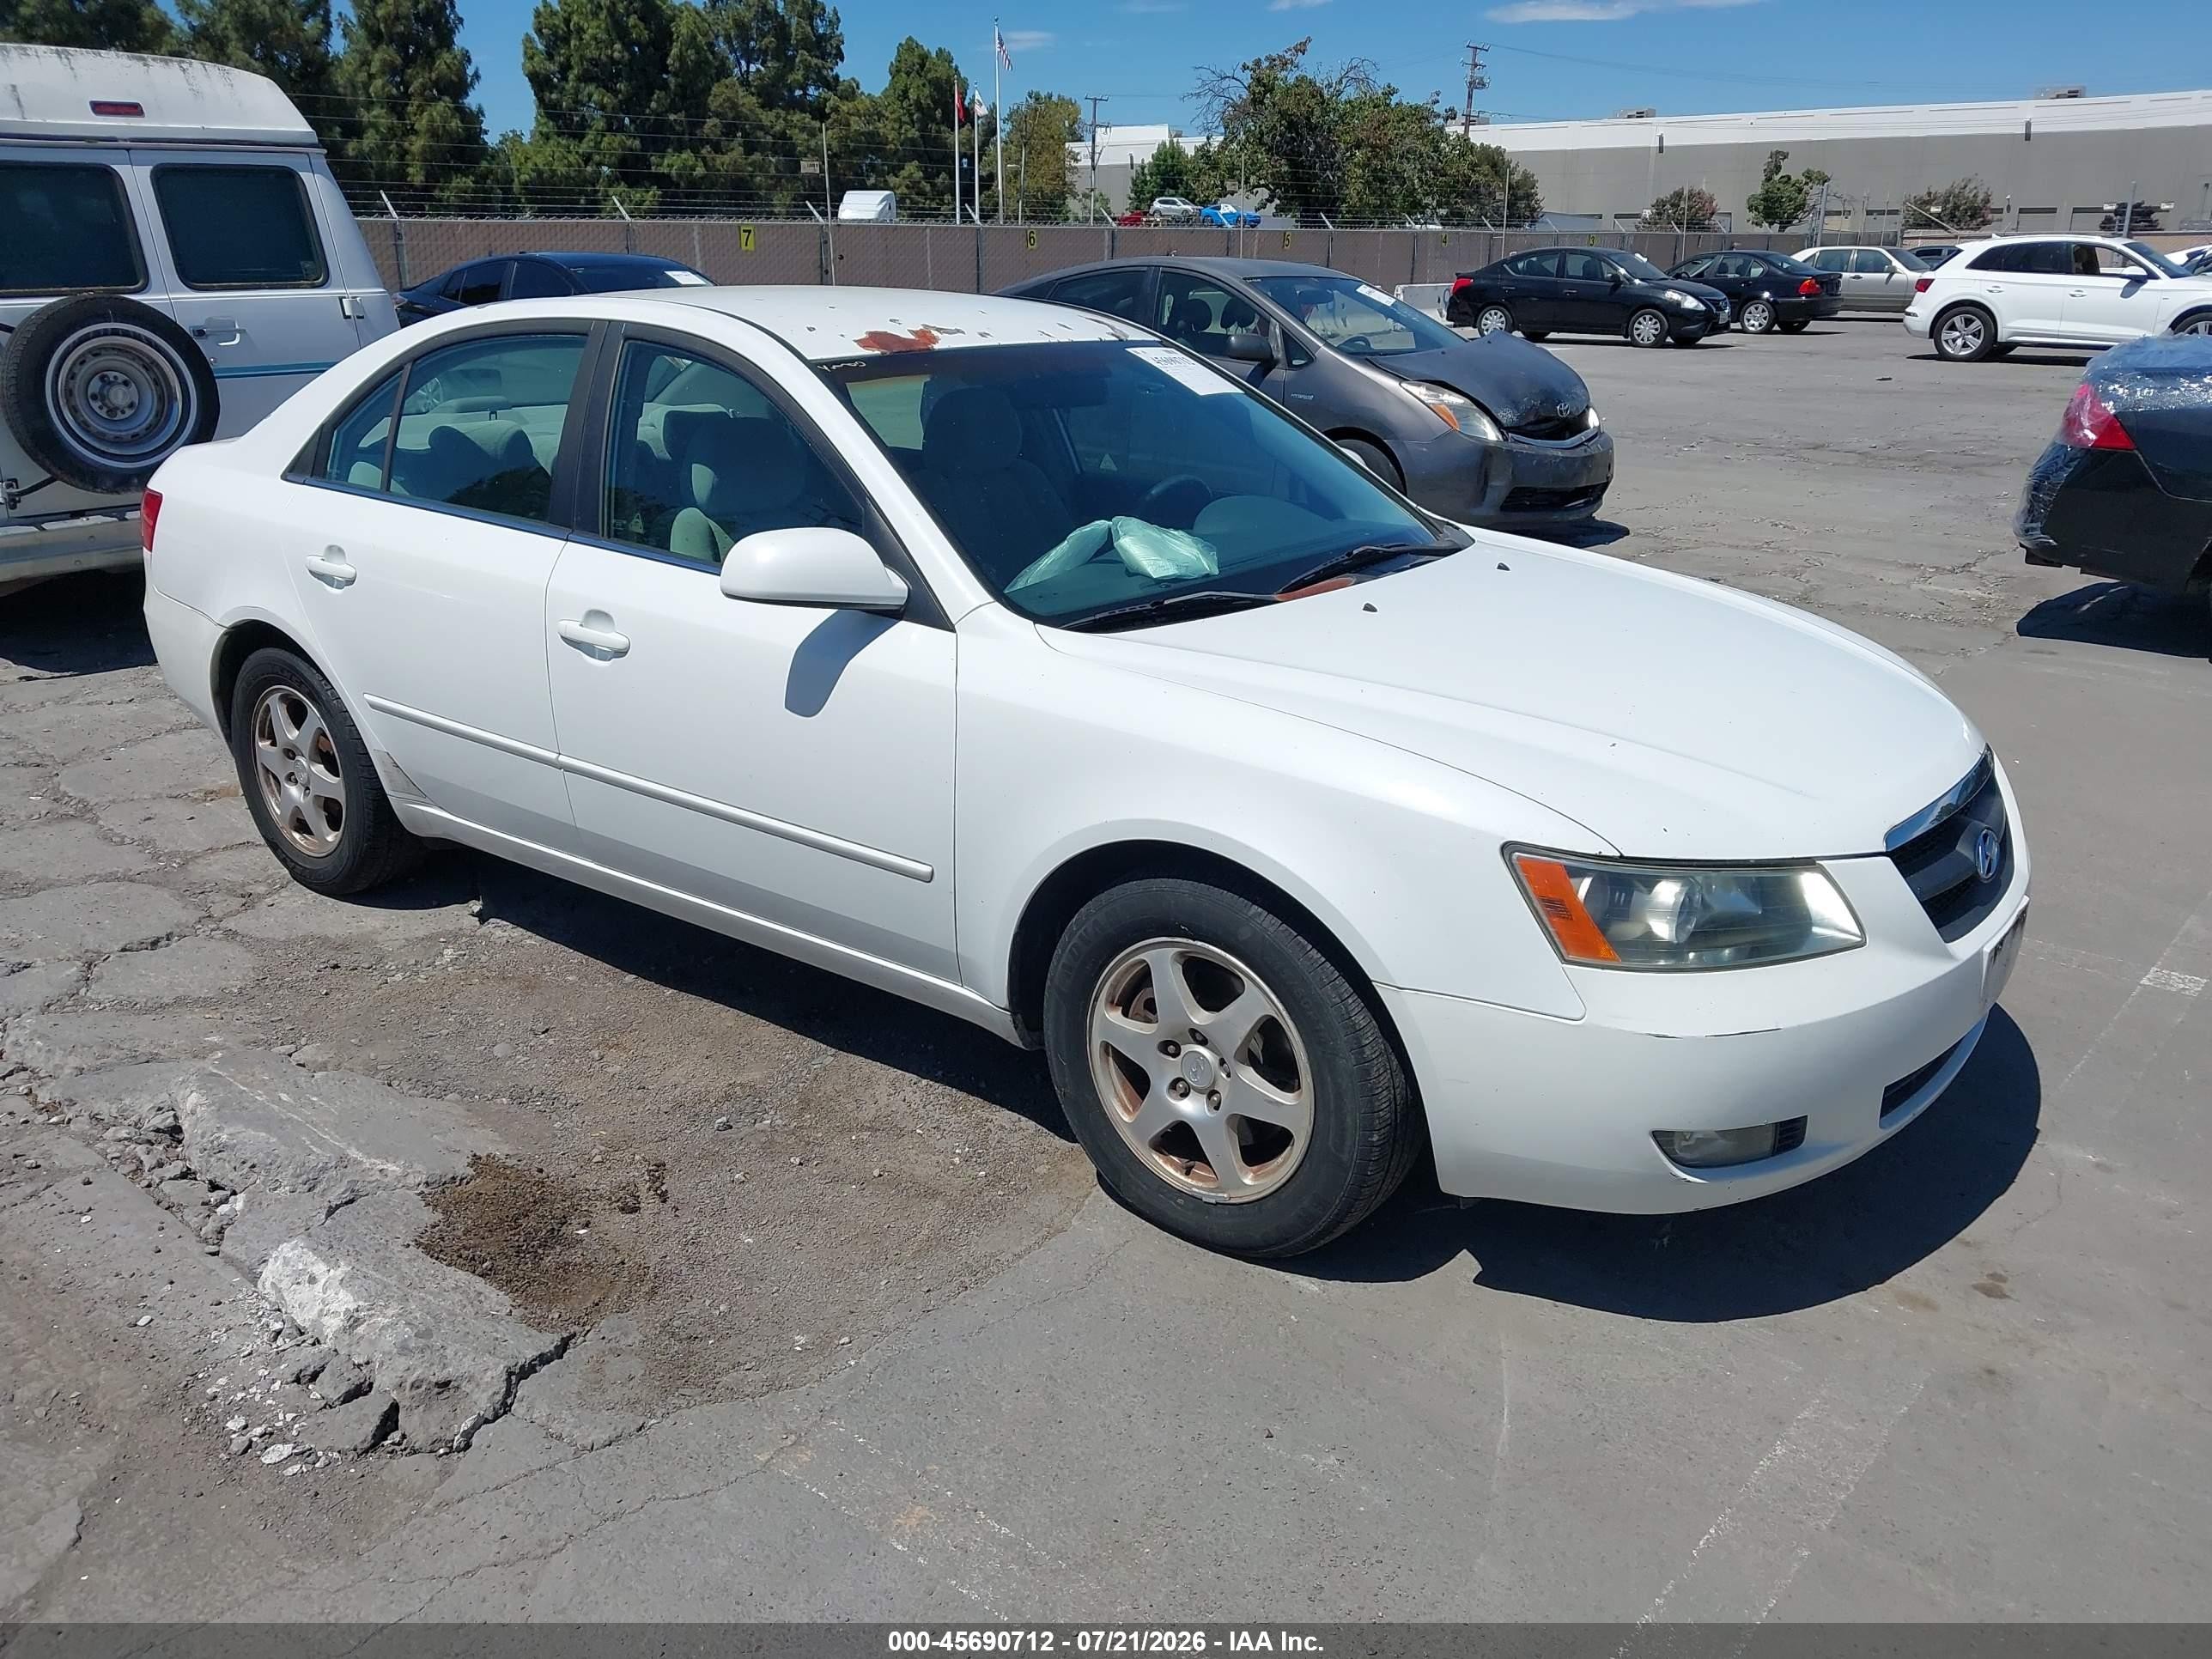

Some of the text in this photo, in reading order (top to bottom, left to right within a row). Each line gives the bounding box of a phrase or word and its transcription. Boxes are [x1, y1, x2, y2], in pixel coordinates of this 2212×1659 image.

[742, 228, 752, 247] 7
[1028, 230, 1036, 246] 6
[1285, 233, 1291, 247] 5
[1442, 233, 1447, 246] 4
[1589, 235, 1595, 246] 3
